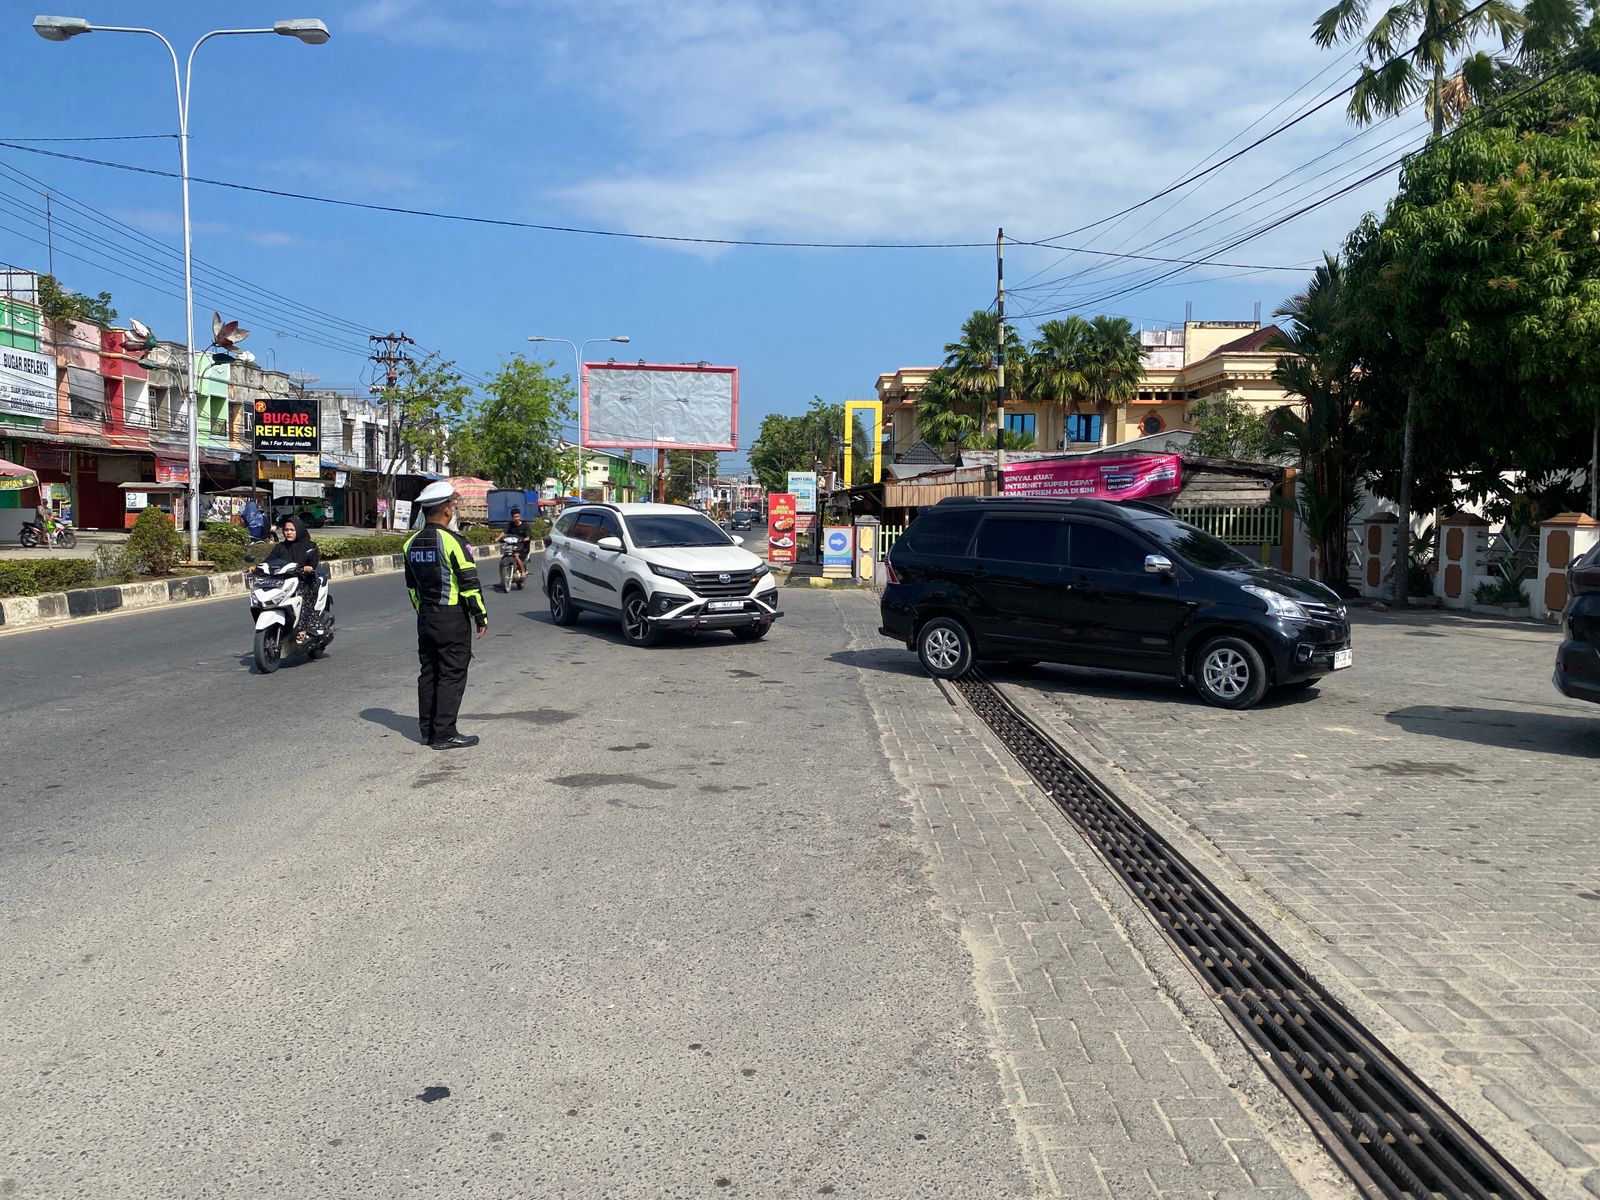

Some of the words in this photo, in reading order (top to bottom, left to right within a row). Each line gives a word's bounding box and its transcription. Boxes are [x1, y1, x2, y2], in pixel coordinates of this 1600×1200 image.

[4, 353, 22, 371] BUGAR
[23, 357, 49, 376] REFLEKSI
[263, 412, 309, 425] BUGAR
[255, 425, 317, 438] REFLEKSI
[1005, 482, 1043, 490] INTERNET
[1043, 480, 1069, 488] SUPER
[1004, 489, 1052, 497] SMARTFREN
[410, 551, 436, 562] POLISI
